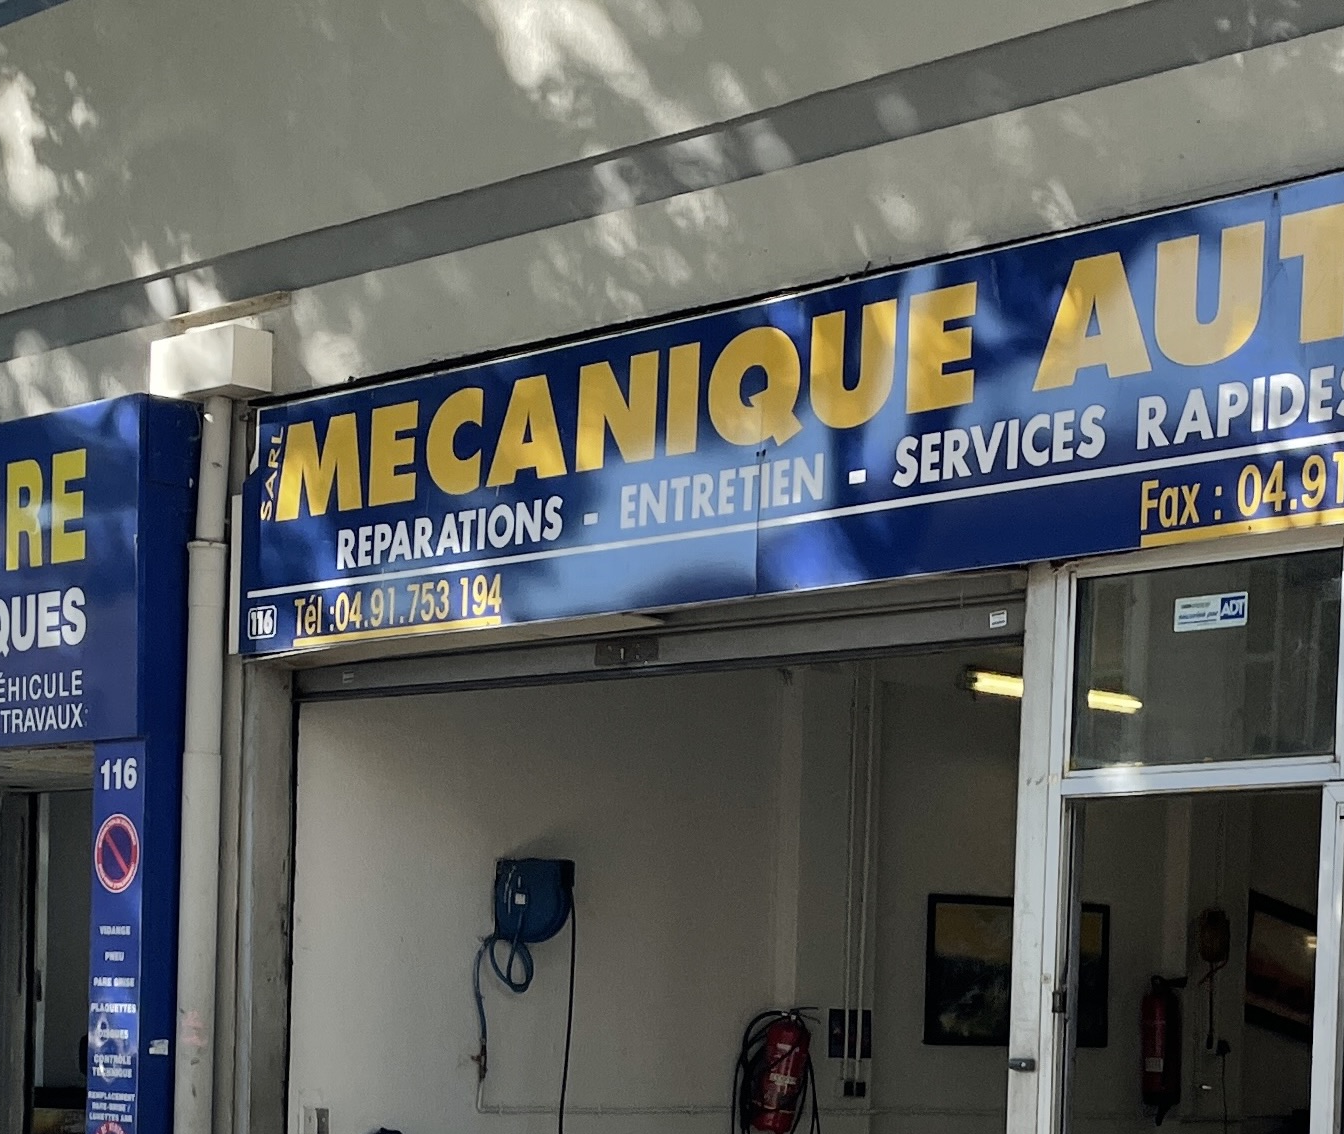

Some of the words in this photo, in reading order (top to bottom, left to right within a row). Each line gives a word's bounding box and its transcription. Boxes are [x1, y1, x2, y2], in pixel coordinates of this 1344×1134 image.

[275, 282, 978, 522] MECANIQUE
[259, 426, 284, 521] SARL
[336, 495, 564, 570] REPARATIONS
[619, 453, 824, 529] ENTRETIEN
[892, 404, 1107, 487] SERVICES
[1139, 478, 1200, 531] Fax
[250, 609, 274, 635] 116
[1220, 598, 1246, 617] ADT
[100, 758, 137, 790] 116
